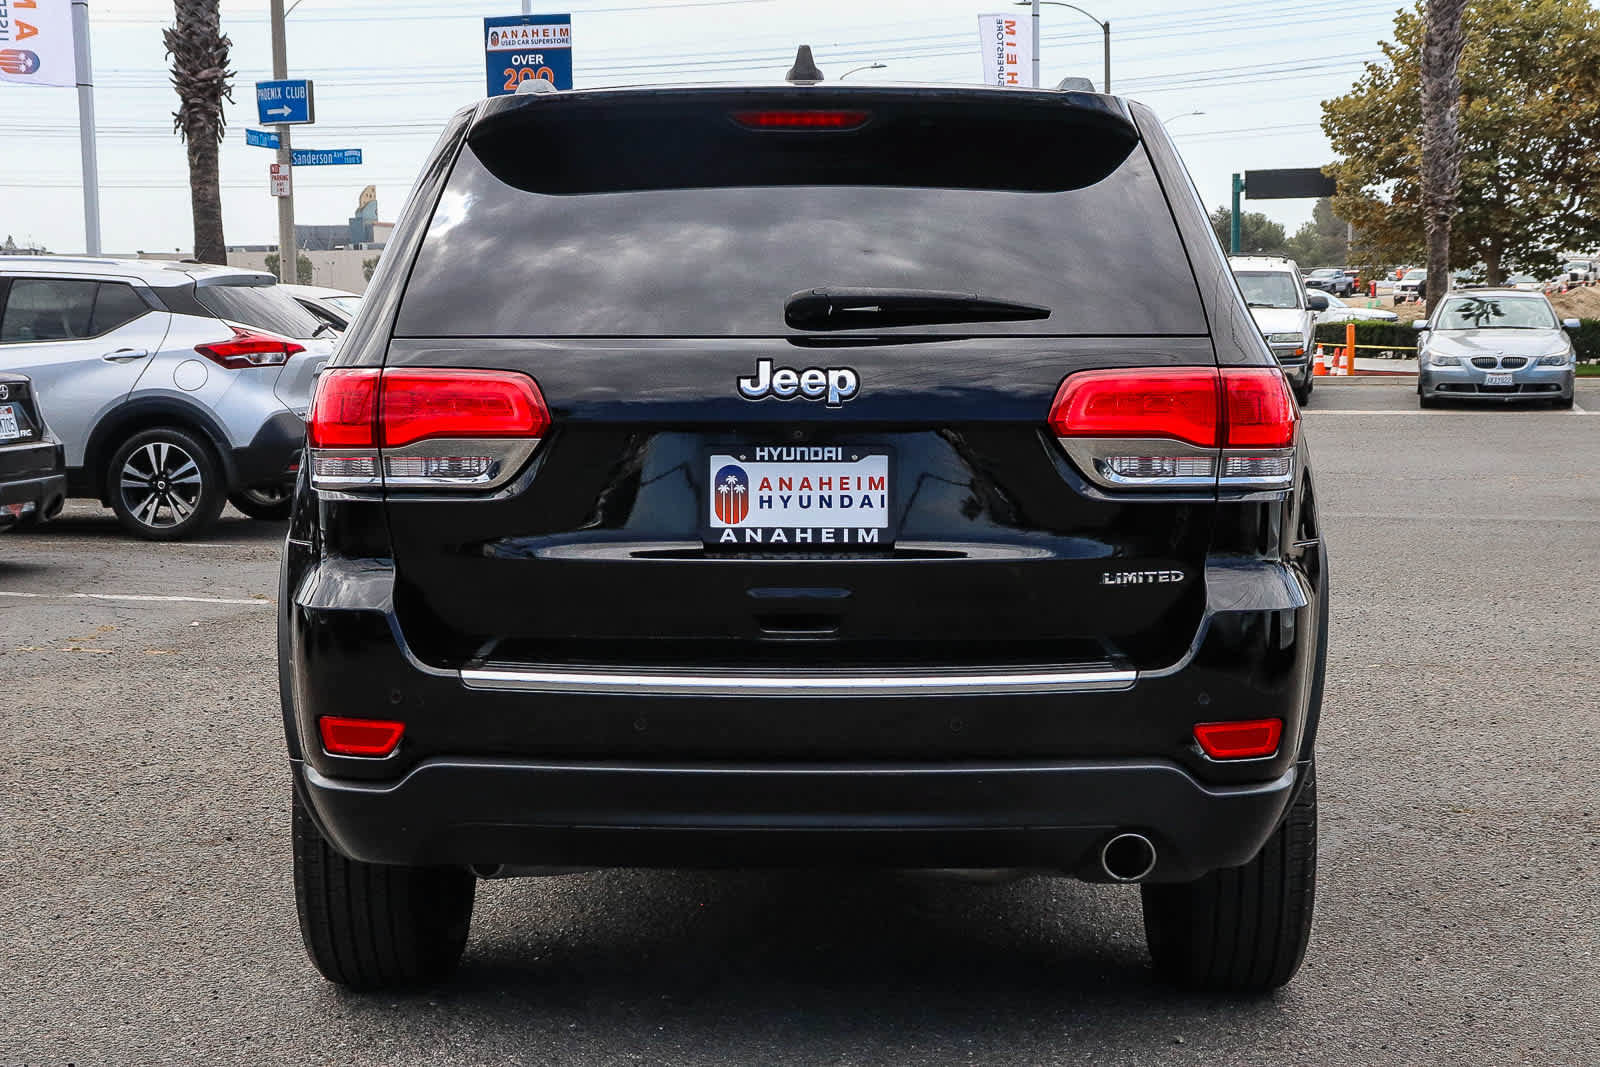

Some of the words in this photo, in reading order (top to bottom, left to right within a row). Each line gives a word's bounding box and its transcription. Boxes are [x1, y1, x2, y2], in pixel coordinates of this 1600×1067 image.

[501, 27, 569, 39] ANAHEIM
[530, 37, 569, 45] SUPERSTORE
[511, 54, 544, 66] OVER
[257, 86, 282, 101] PHOENIX
[285, 86, 306, 99] CLUB
[292, 152, 333, 165] Sanderson
[738, 359, 859, 405] Jeep
[755, 447, 843, 461] HYUNDAI
[758, 476, 885, 492] ANAHEIM
[758, 494, 885, 509] HYUNDAI
[719, 528, 879, 543] ANAHEIM
[1103, 570, 1185, 585] LIMITED
